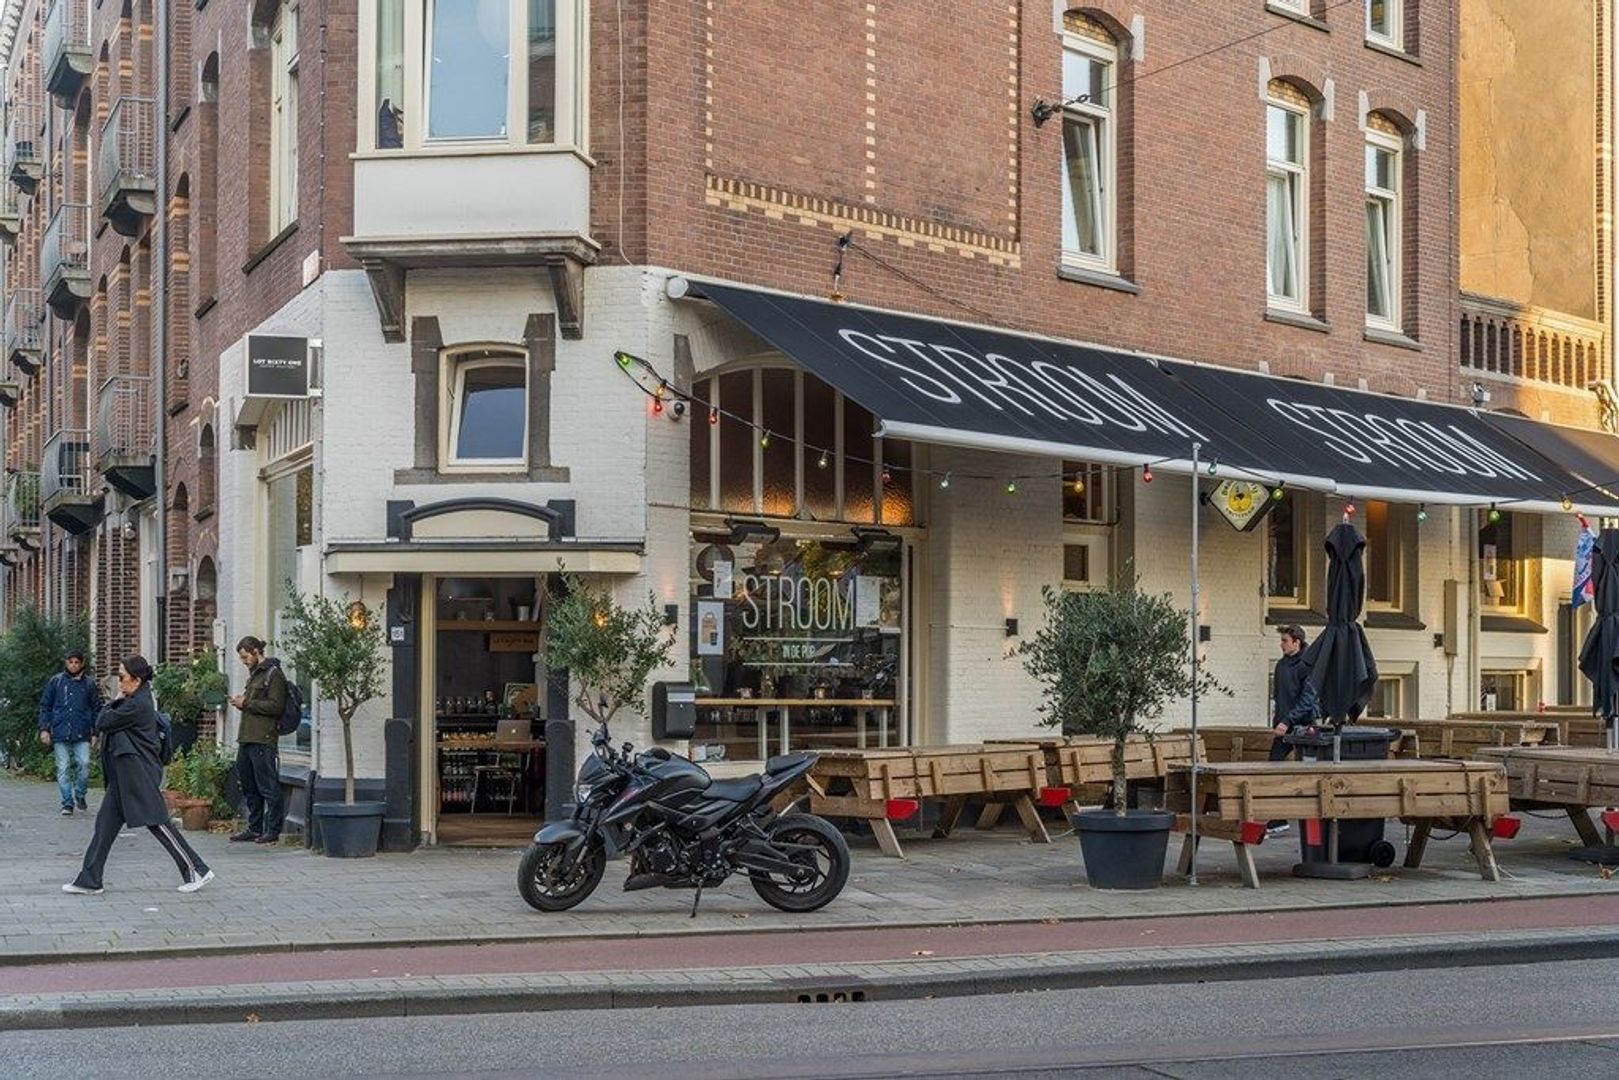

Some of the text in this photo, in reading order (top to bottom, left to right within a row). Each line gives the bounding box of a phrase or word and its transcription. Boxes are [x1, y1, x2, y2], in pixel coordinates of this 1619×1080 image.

[838, 329, 1210, 442] STROOM
[1266, 398, 1543, 482] STROOM
[742, 574, 854, 631] STROOM
